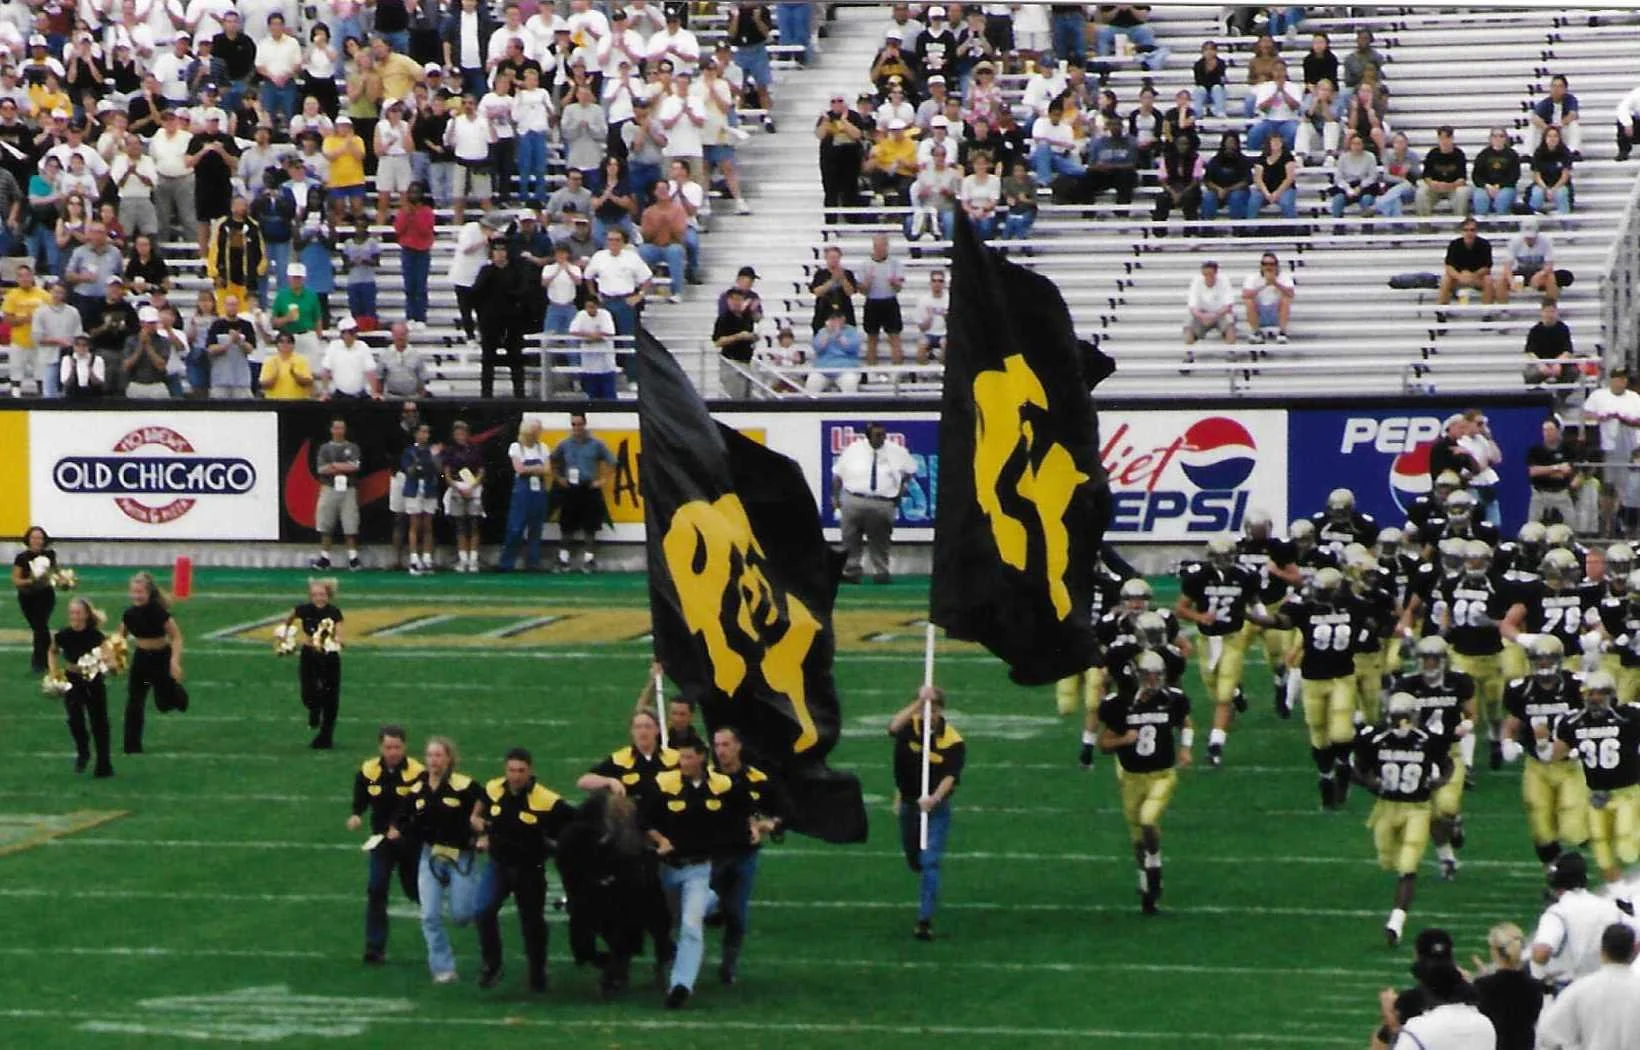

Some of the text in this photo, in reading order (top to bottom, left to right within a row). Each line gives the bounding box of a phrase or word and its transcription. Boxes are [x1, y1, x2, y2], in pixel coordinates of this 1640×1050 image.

[1341, 417, 1443, 453] PEP
[56, 461, 254, 490] OLD CHICAGO
[1109, 491, 1249, 532] EPSI
[1135, 725, 1157, 756] 8
[1579, 738, 1621, 769] 36
